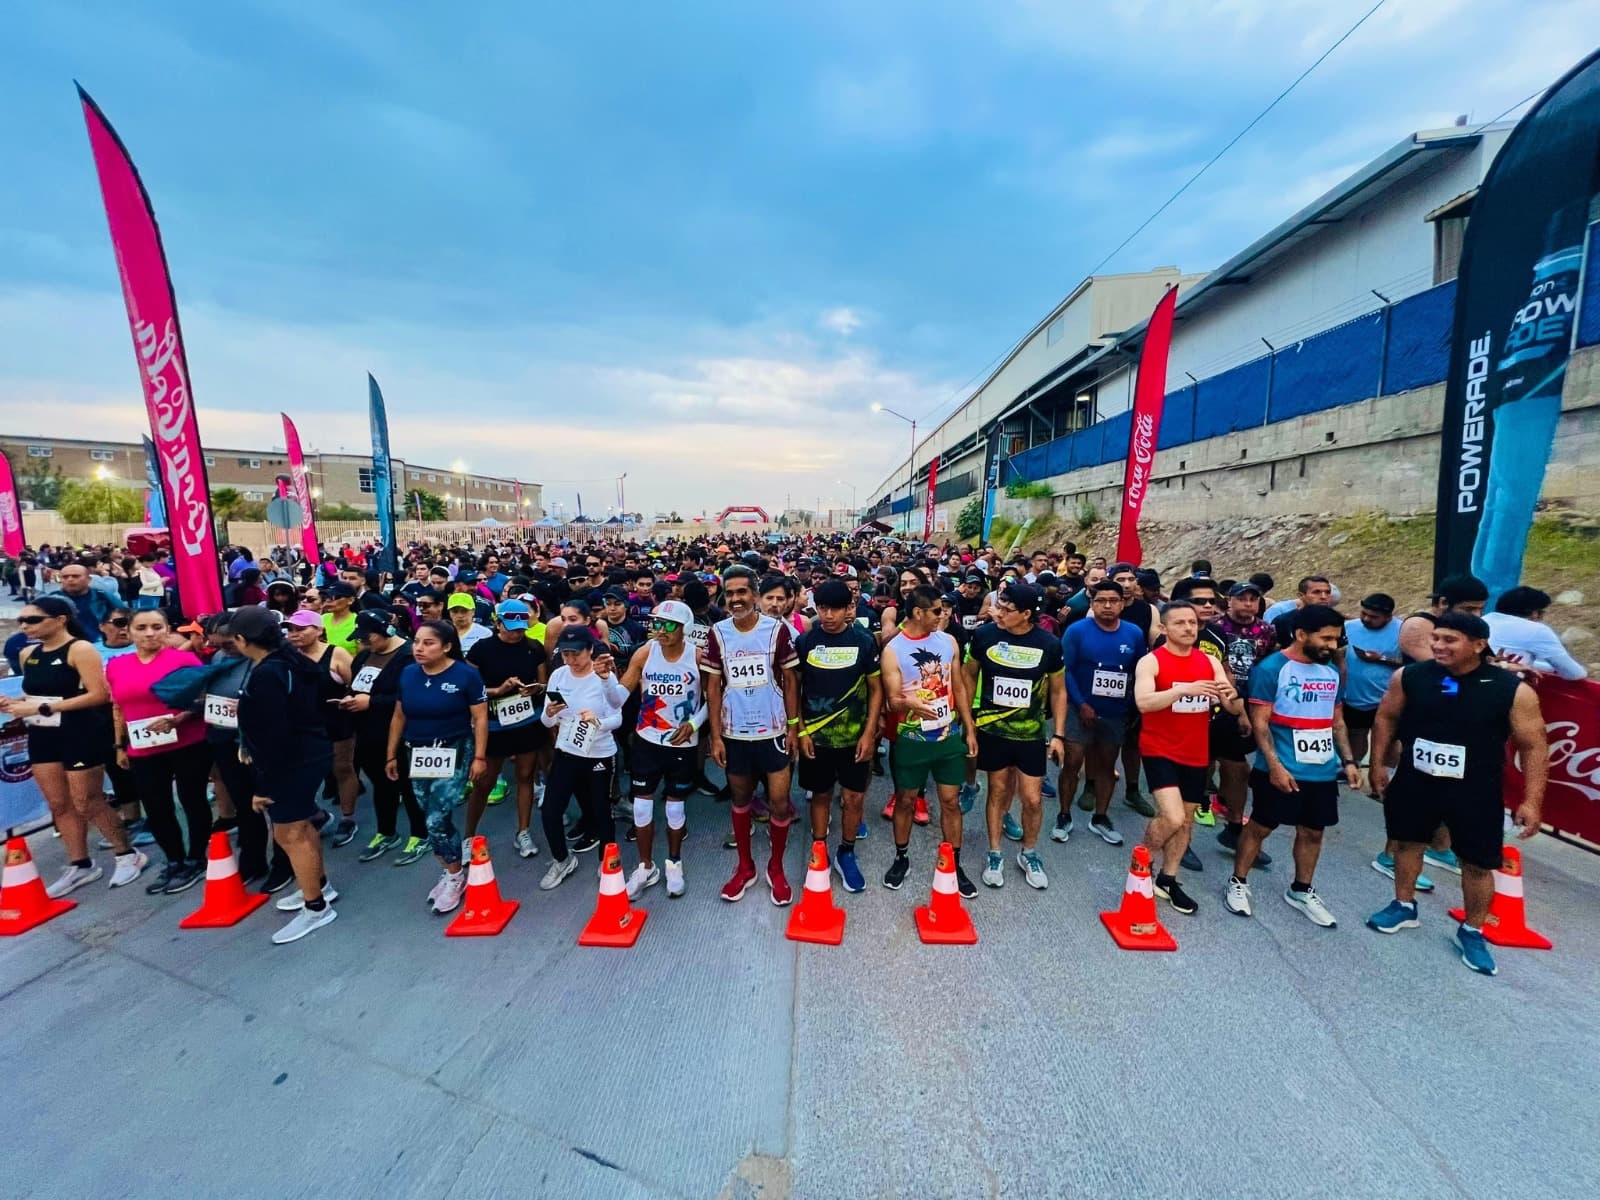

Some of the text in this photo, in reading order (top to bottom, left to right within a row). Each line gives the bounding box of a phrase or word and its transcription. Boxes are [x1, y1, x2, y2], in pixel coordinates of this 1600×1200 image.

[687, 629, 709, 641] 022
[645, 672, 682, 684] Integon
[731, 664, 764, 678] 3415
[650, 683, 683, 696] 3062
[1095, 677, 1124, 690] 3306
[996, 685, 1028, 699] 0400
[500, 700, 531, 717] 1868
[573, 720, 589, 748] 5080
[1297, 738, 1332, 753] 0435
[414, 756, 452, 769] 5001
[1415, 747, 1460, 768] 2165
